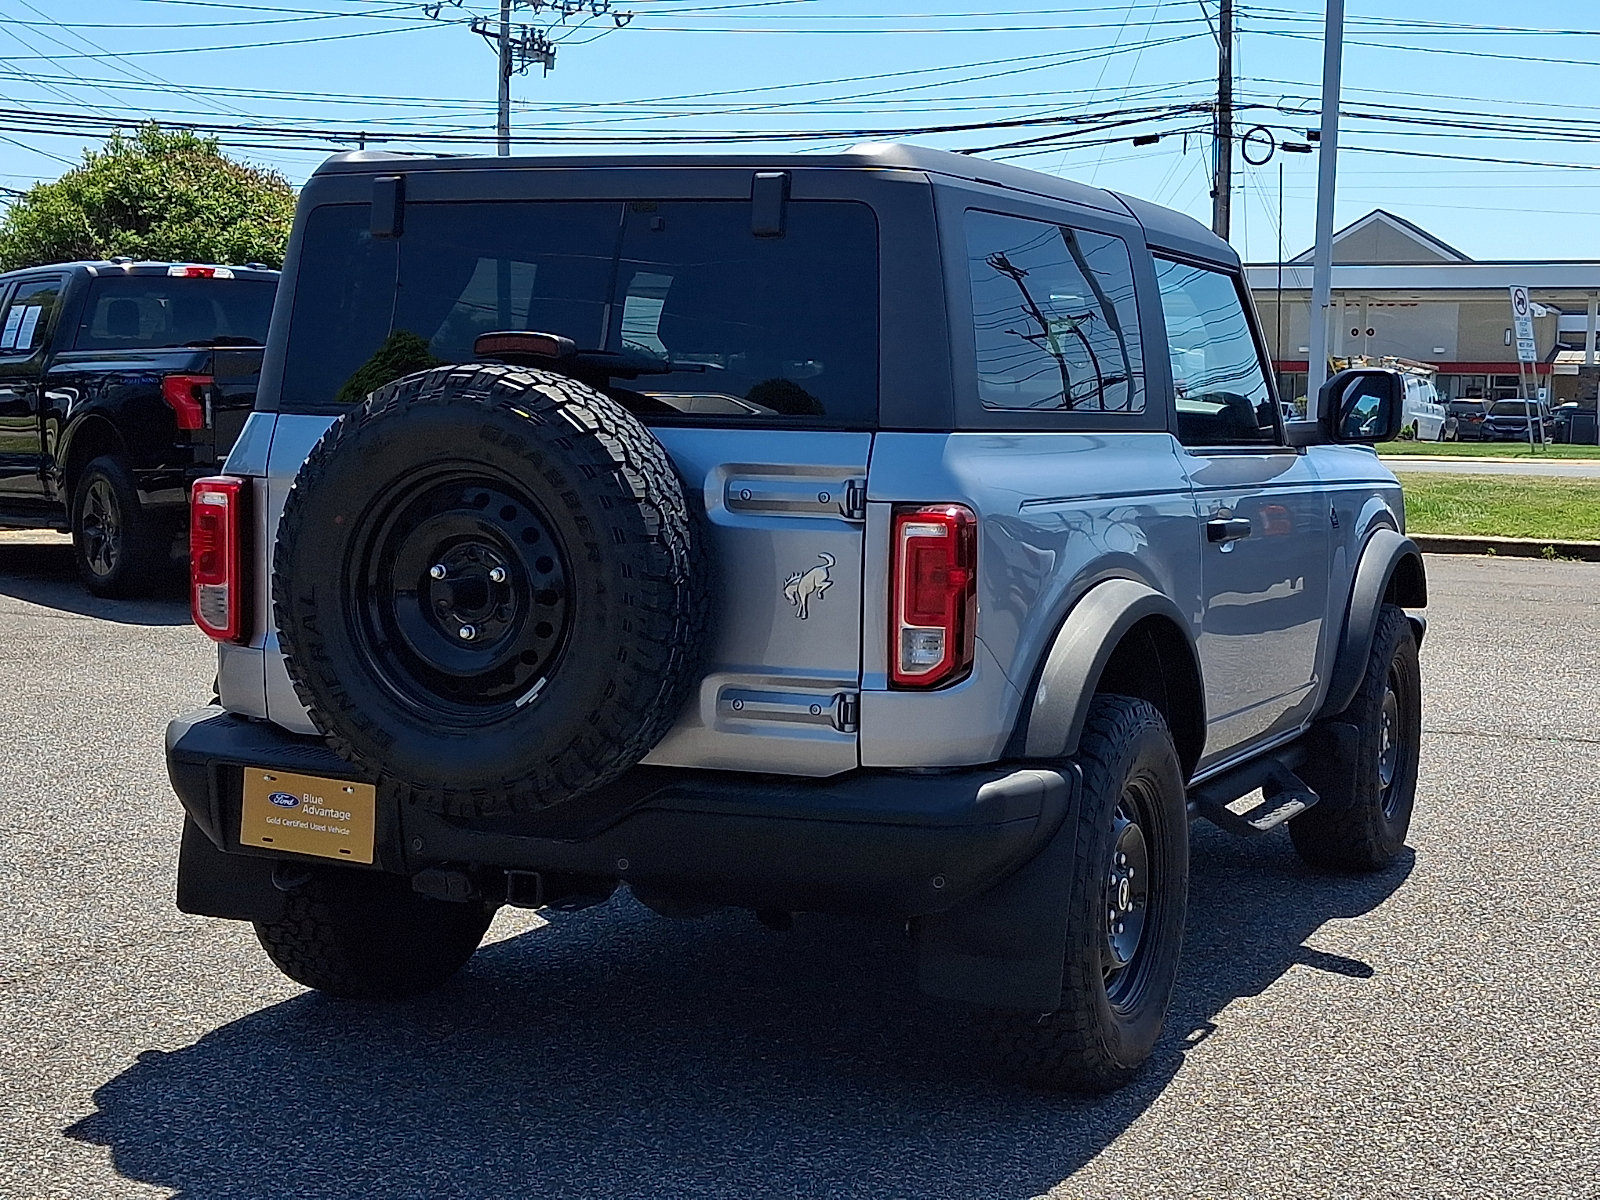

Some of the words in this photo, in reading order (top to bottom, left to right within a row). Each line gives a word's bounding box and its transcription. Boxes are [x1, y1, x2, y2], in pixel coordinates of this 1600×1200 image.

[478, 425, 601, 562] GRABBER
[299, 584, 396, 750] GENERAL
[272, 793, 296, 806] Ford
[303, 793, 323, 804] Blue
[302, 804, 351, 820] Advantage
[266, 816, 281, 825] Gold
[282, 818, 309, 829] Certified
[310, 822, 326, 832] Used
[327, 825, 351, 835] Vehicle
